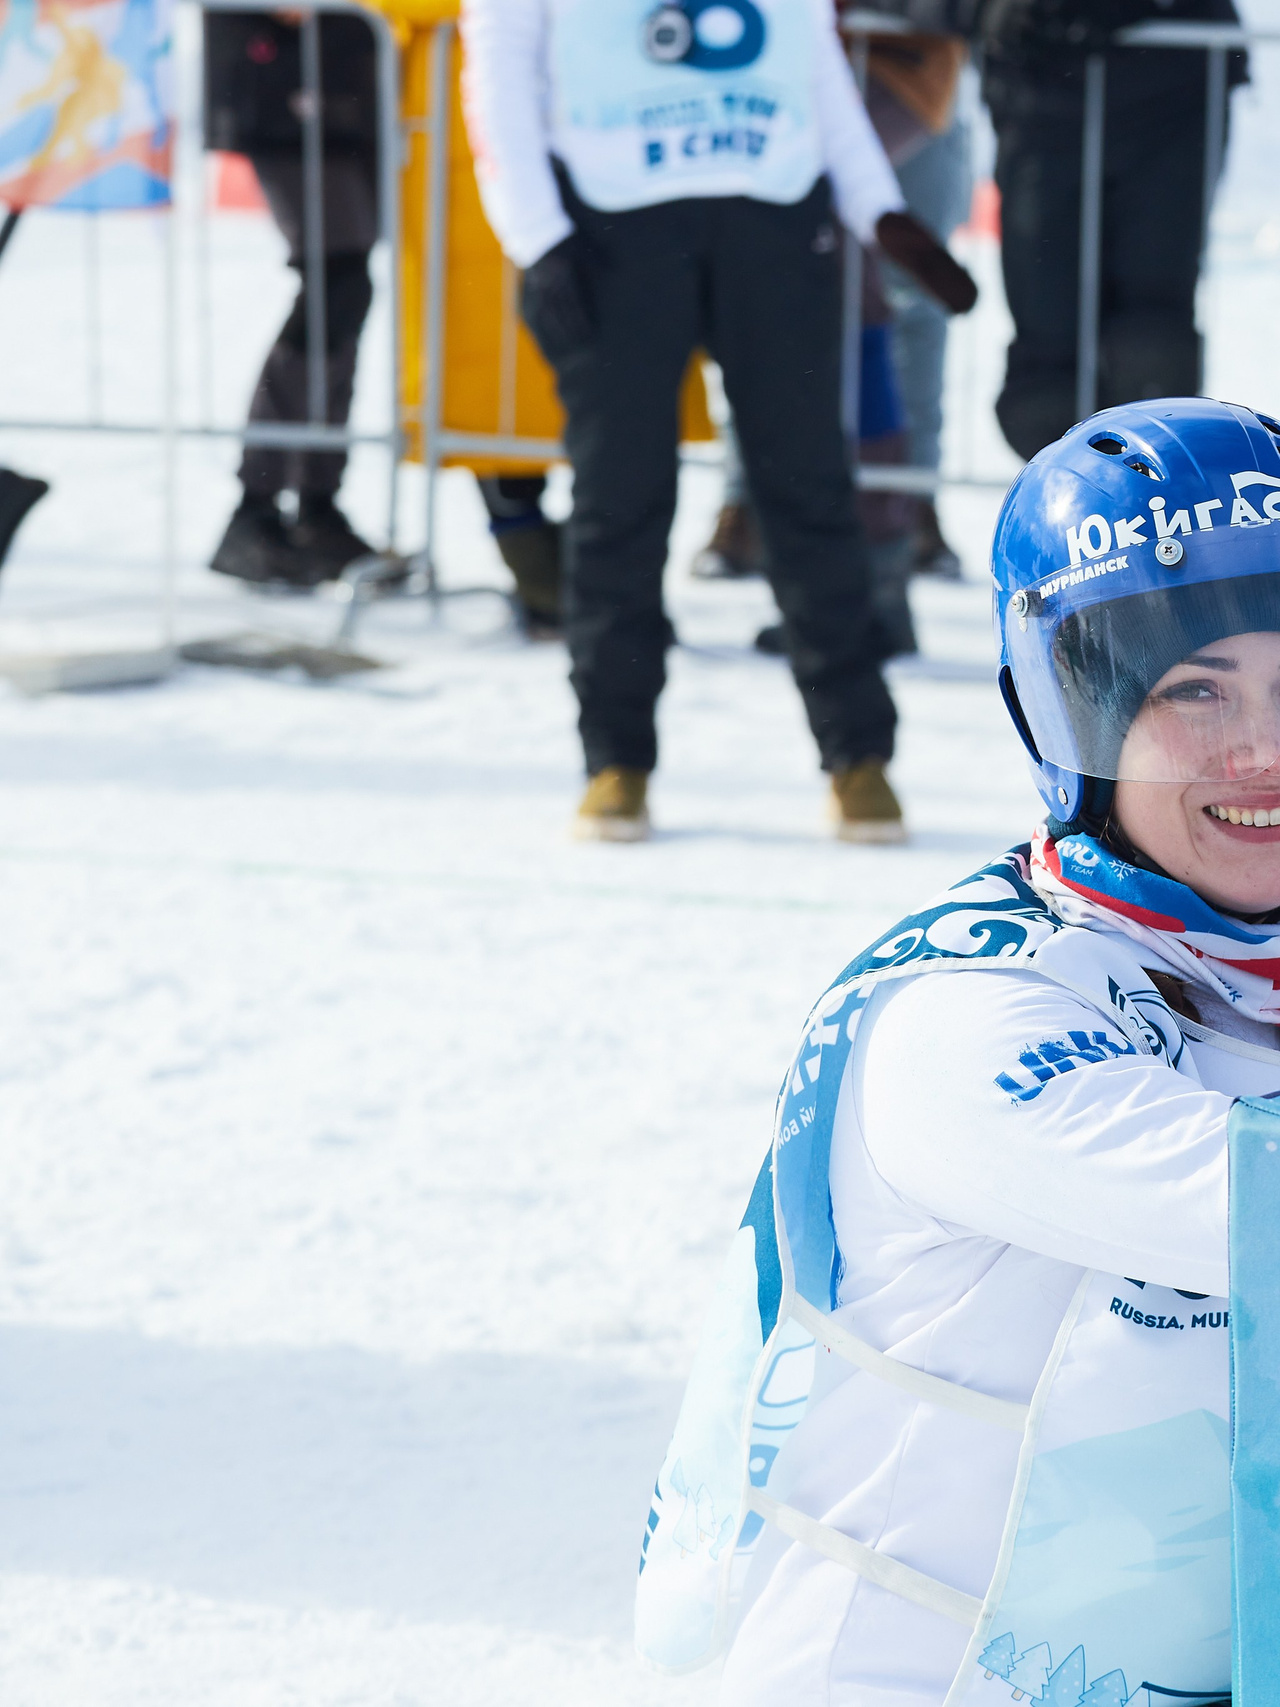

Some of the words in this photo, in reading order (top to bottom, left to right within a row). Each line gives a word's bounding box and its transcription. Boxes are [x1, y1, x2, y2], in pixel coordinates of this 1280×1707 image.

[1039, 555, 1129, 600] МУРМАНСК
[1070, 864, 1094, 877] TEAM
[1109, 1296, 1185, 1330] RUSSIA,
